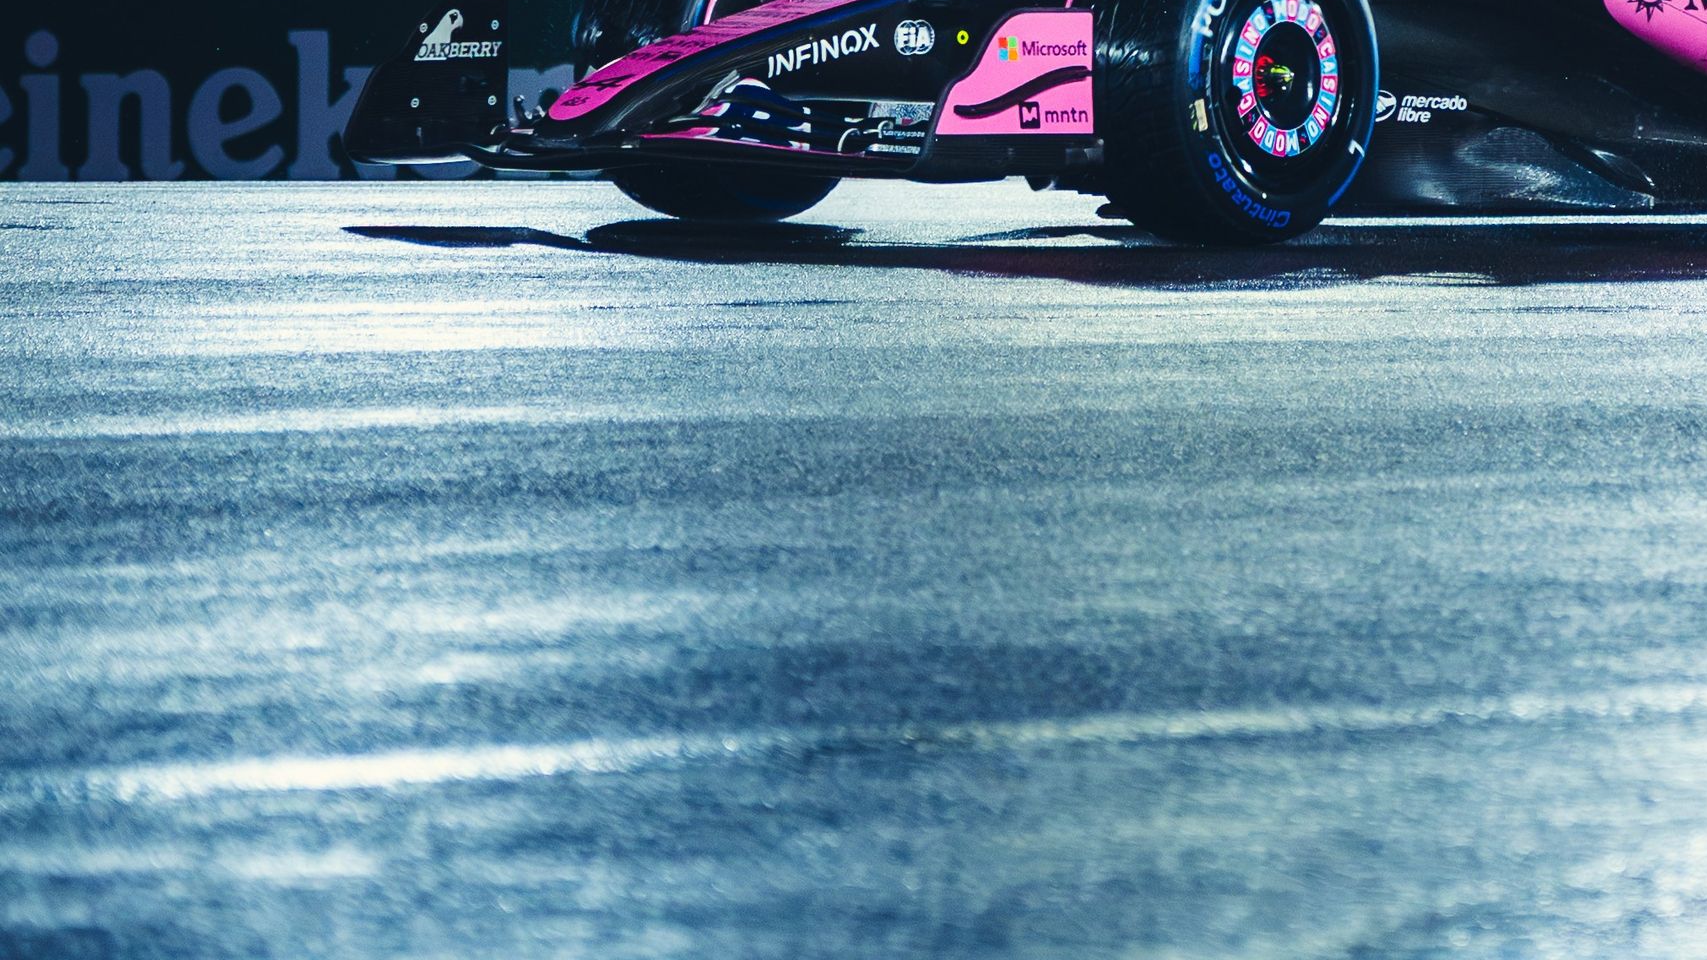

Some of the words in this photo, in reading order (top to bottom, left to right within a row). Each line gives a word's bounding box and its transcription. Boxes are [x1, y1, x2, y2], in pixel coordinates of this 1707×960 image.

[417, 41, 502, 59] OAKBERRY
[768, 23, 880, 78] INFINOX
[1022, 40, 1087, 56] Microsoft
[1401, 95, 1468, 111] mercado
[1044, 107, 1088, 123] mntn
[1397, 107, 1431, 123] libre
